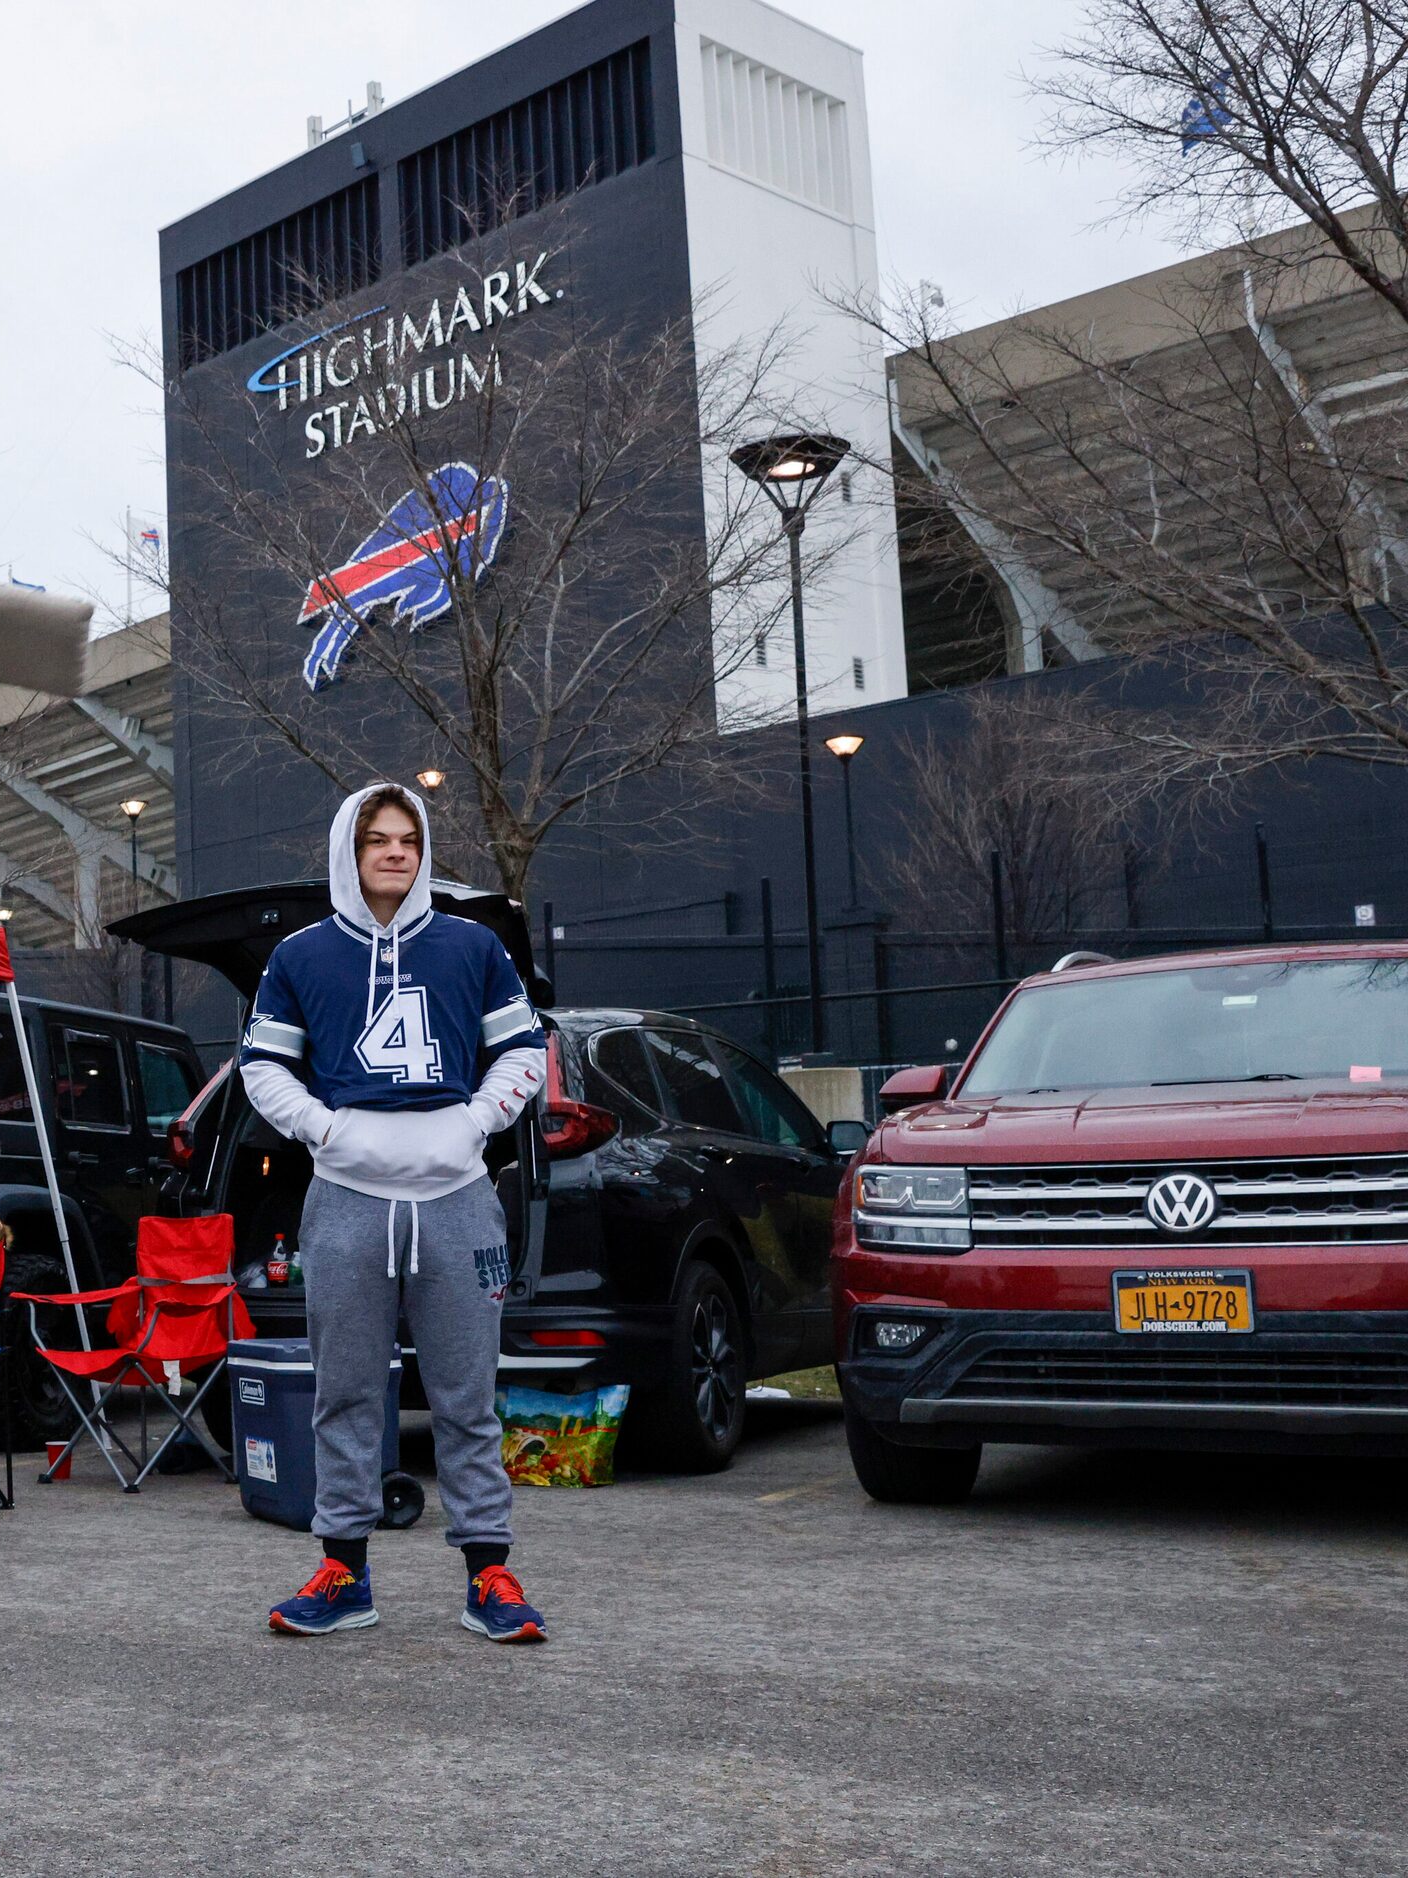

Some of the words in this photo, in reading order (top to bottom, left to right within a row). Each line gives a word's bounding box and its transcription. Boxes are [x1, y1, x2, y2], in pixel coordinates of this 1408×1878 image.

[303, 344, 503, 459] STADIUM
[353, 986, 443, 1083] 4
[1148, 1278, 1178, 1286] NEW
[1142, 1321, 1227, 1332] DORSCHEL.COM
